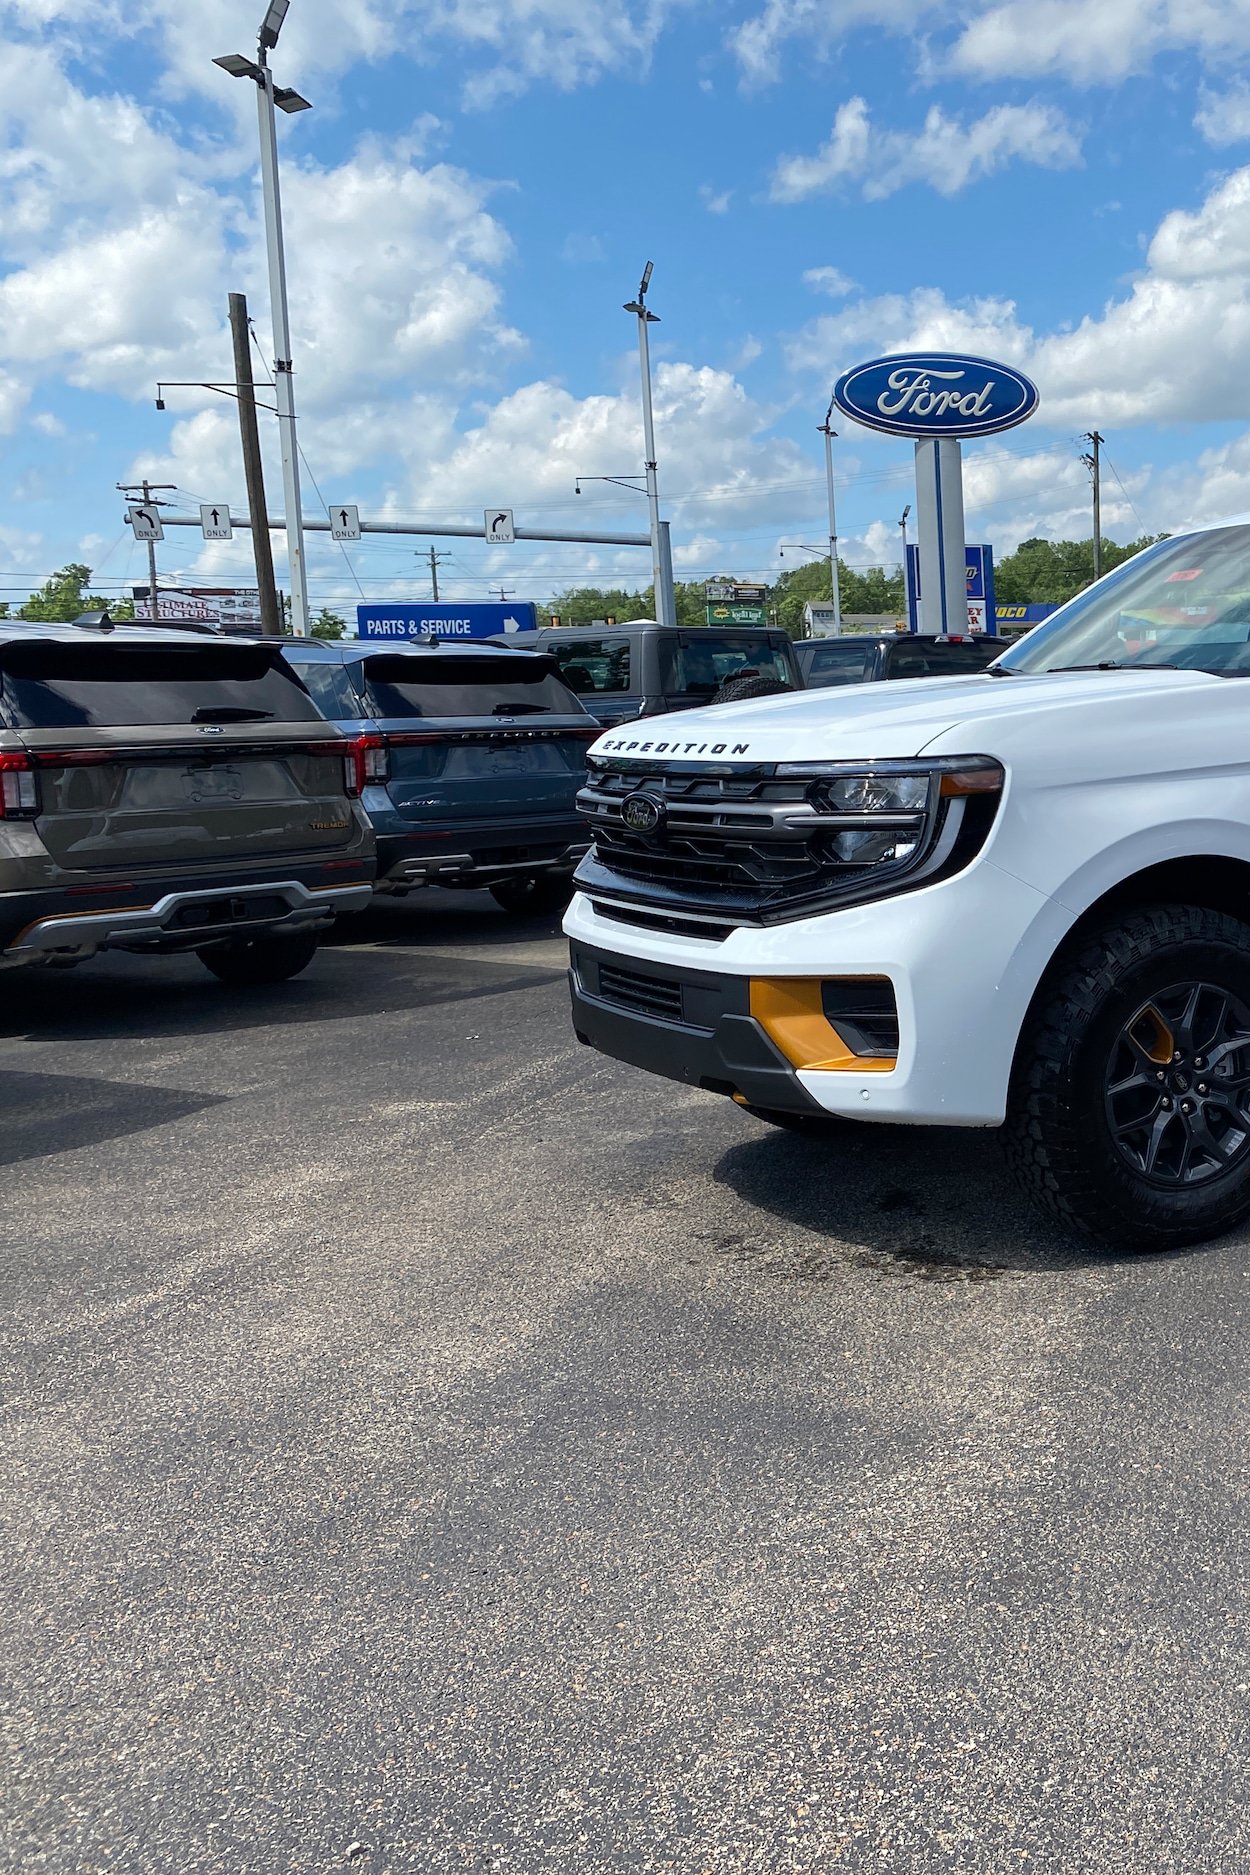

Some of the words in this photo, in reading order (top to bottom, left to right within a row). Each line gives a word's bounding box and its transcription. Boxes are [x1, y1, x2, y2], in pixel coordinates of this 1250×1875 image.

[877, 368, 995, 416] Ford
[138, 530, 160, 538] ONLY
[206, 529, 228, 537] ONLY
[335, 530, 356, 538] ONLY
[489, 533, 511, 541] ONLY
[995, 606, 1027, 618] OCO
[367, 620, 405, 635] PARTS
[408, 620, 418, 634] &
[421, 619, 471, 634] SERVICE
[602, 740, 750, 755] EXPEDITION
[626, 800, 651, 827] Ford
